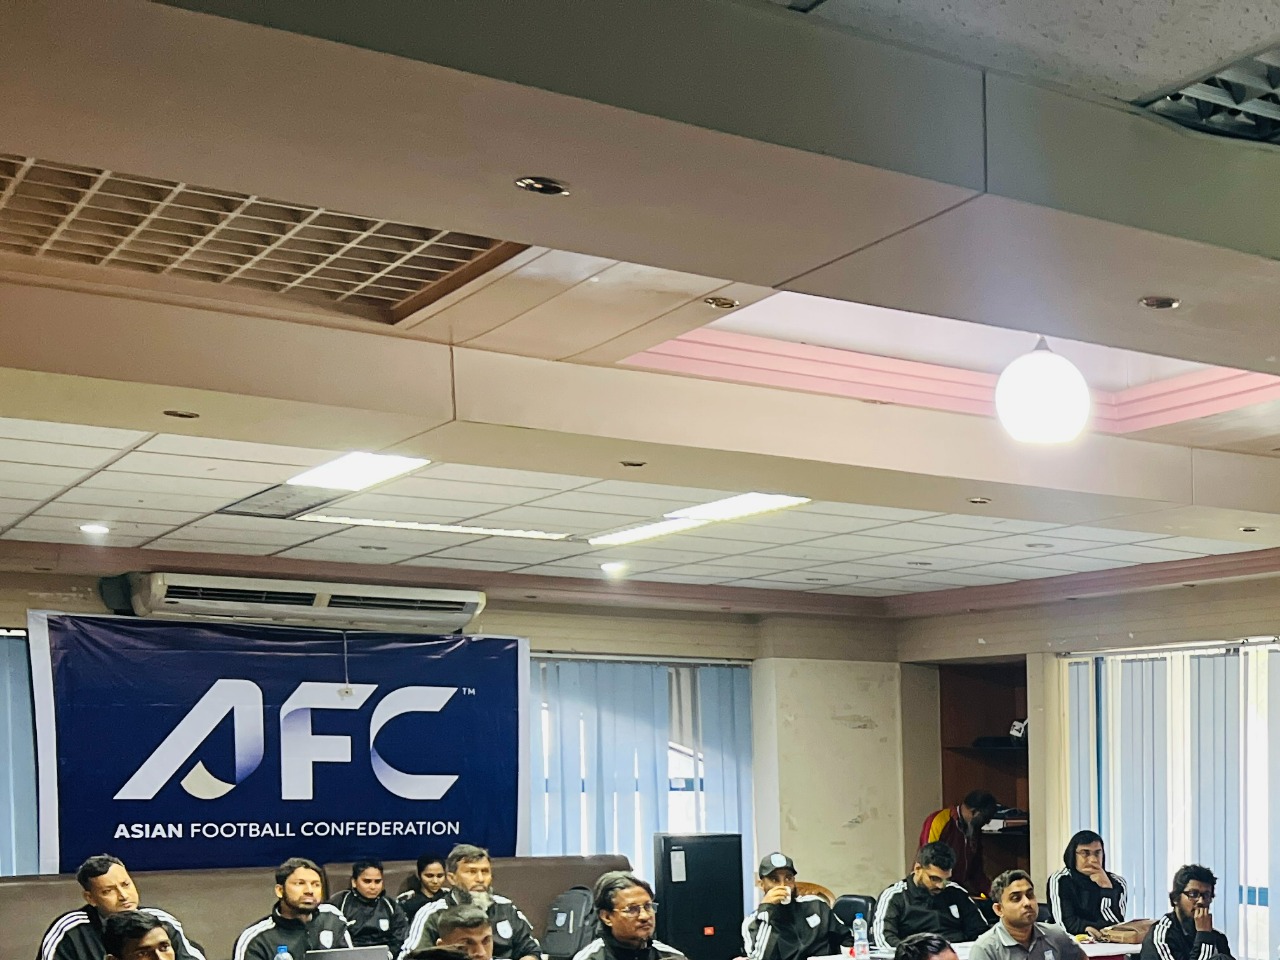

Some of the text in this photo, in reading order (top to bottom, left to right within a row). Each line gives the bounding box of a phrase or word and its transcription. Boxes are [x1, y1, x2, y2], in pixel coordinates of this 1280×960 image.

[113, 678, 459, 800] AFC
[114, 820, 460, 839] ASIAN FOOTBALL CONFEDERATION
